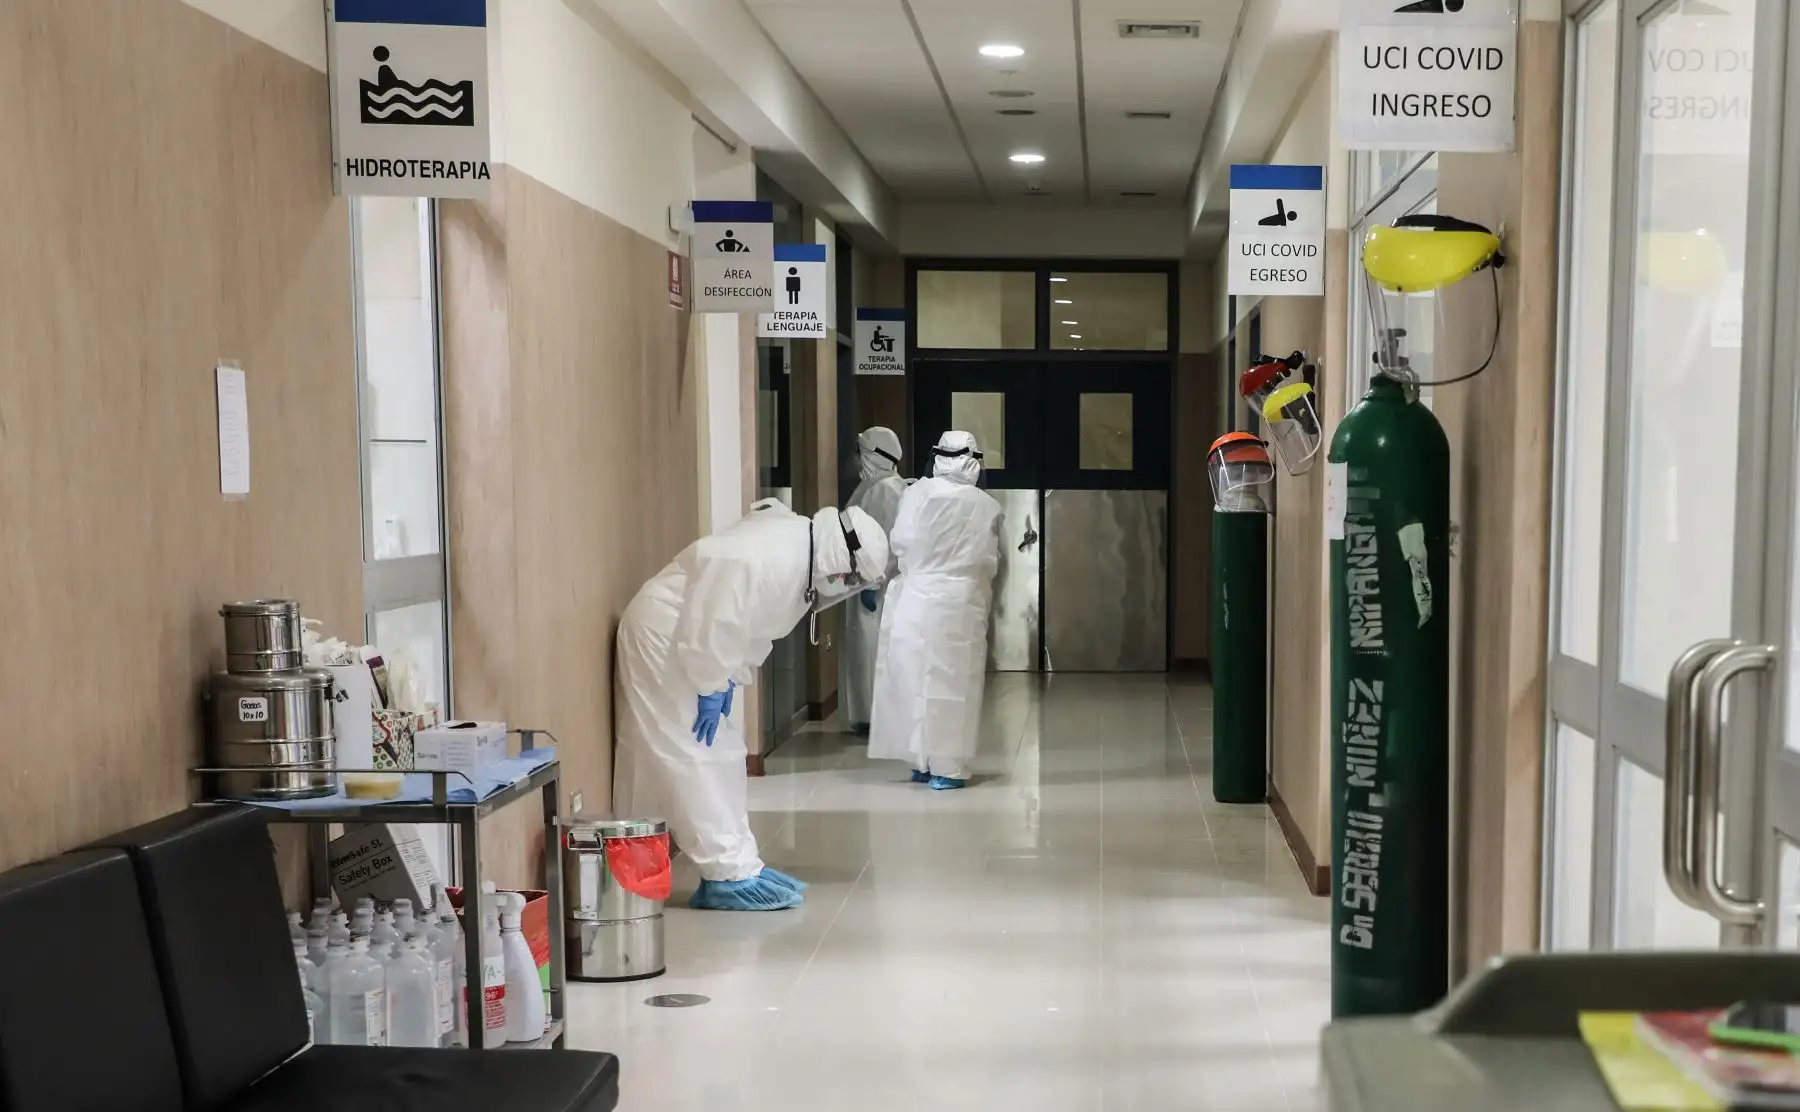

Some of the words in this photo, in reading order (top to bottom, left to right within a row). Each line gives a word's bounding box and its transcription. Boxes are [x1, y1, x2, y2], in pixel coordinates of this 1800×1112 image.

[1363, 45, 1407, 69] UCI
[1417, 46, 1504, 71] COVID
[1372, 93, 1492, 118] INGRESO
[346, 157, 491, 180] HIDROTERAPIA
[1241, 243, 1266, 256] UCI
[1271, 243, 1317, 257] COVID
[723, 267, 752, 279] ÁREA
[1250, 268, 1308, 282] EGRESO
[704, 286, 772, 297] DESIFECCIÓN
[774, 311, 818, 320] TERAPIA
[766, 322, 824, 332] LENGUAJE
[858, 363, 905, 371] OCUPACIONAL
[338, 863, 370, 885] Safety
[372, 855, 393, 869] Box
